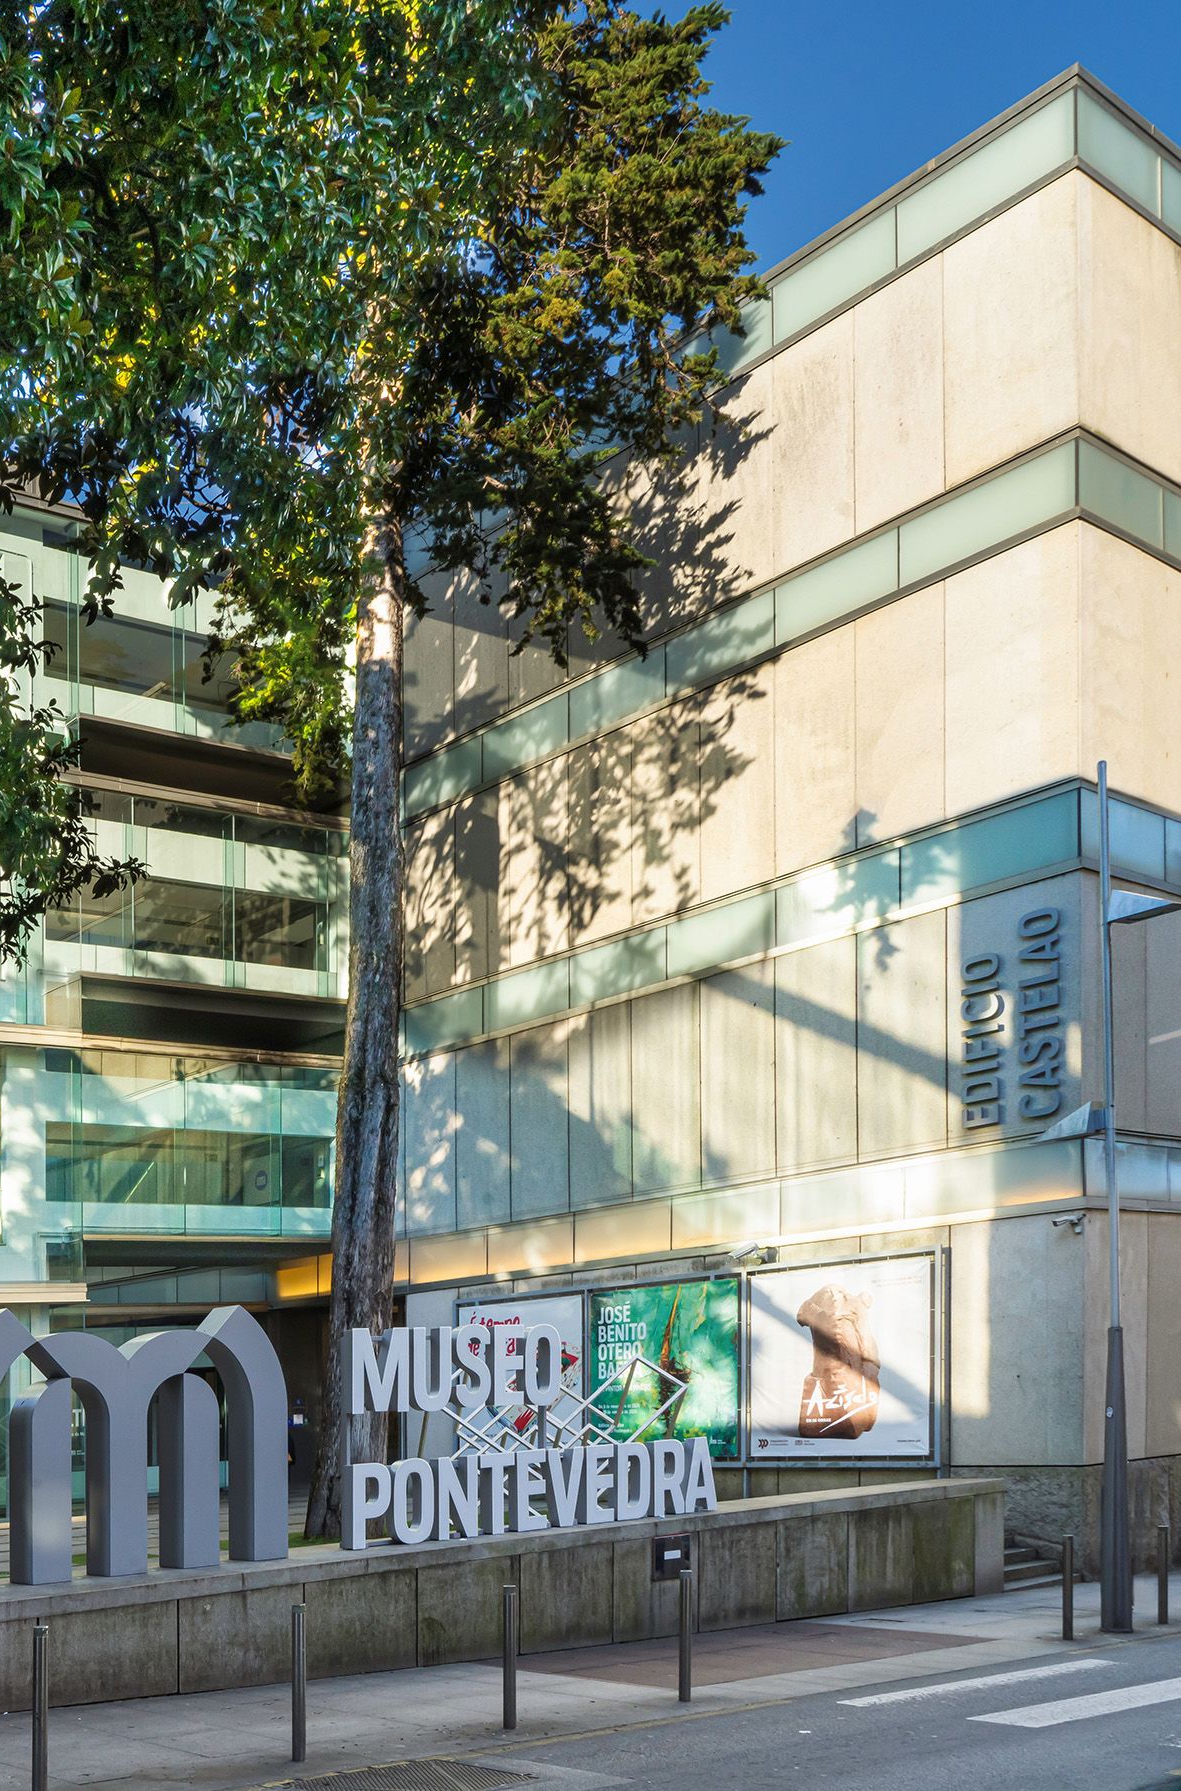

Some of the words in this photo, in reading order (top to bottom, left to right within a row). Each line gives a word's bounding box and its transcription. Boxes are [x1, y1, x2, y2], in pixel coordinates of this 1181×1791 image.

[961, 952, 1002, 1129] EDIFICIO
[1018, 906, 1060, 1119] CASTELAO
[597, 1301, 631, 1325] JOSÉ
[597, 1322, 647, 1343] BENITO
[597, 1341, 642, 1361] OTERO
[343, 1323, 561, 1414] MUSEO
[343, 1436, 718, 1549] PONTEVEDRA
